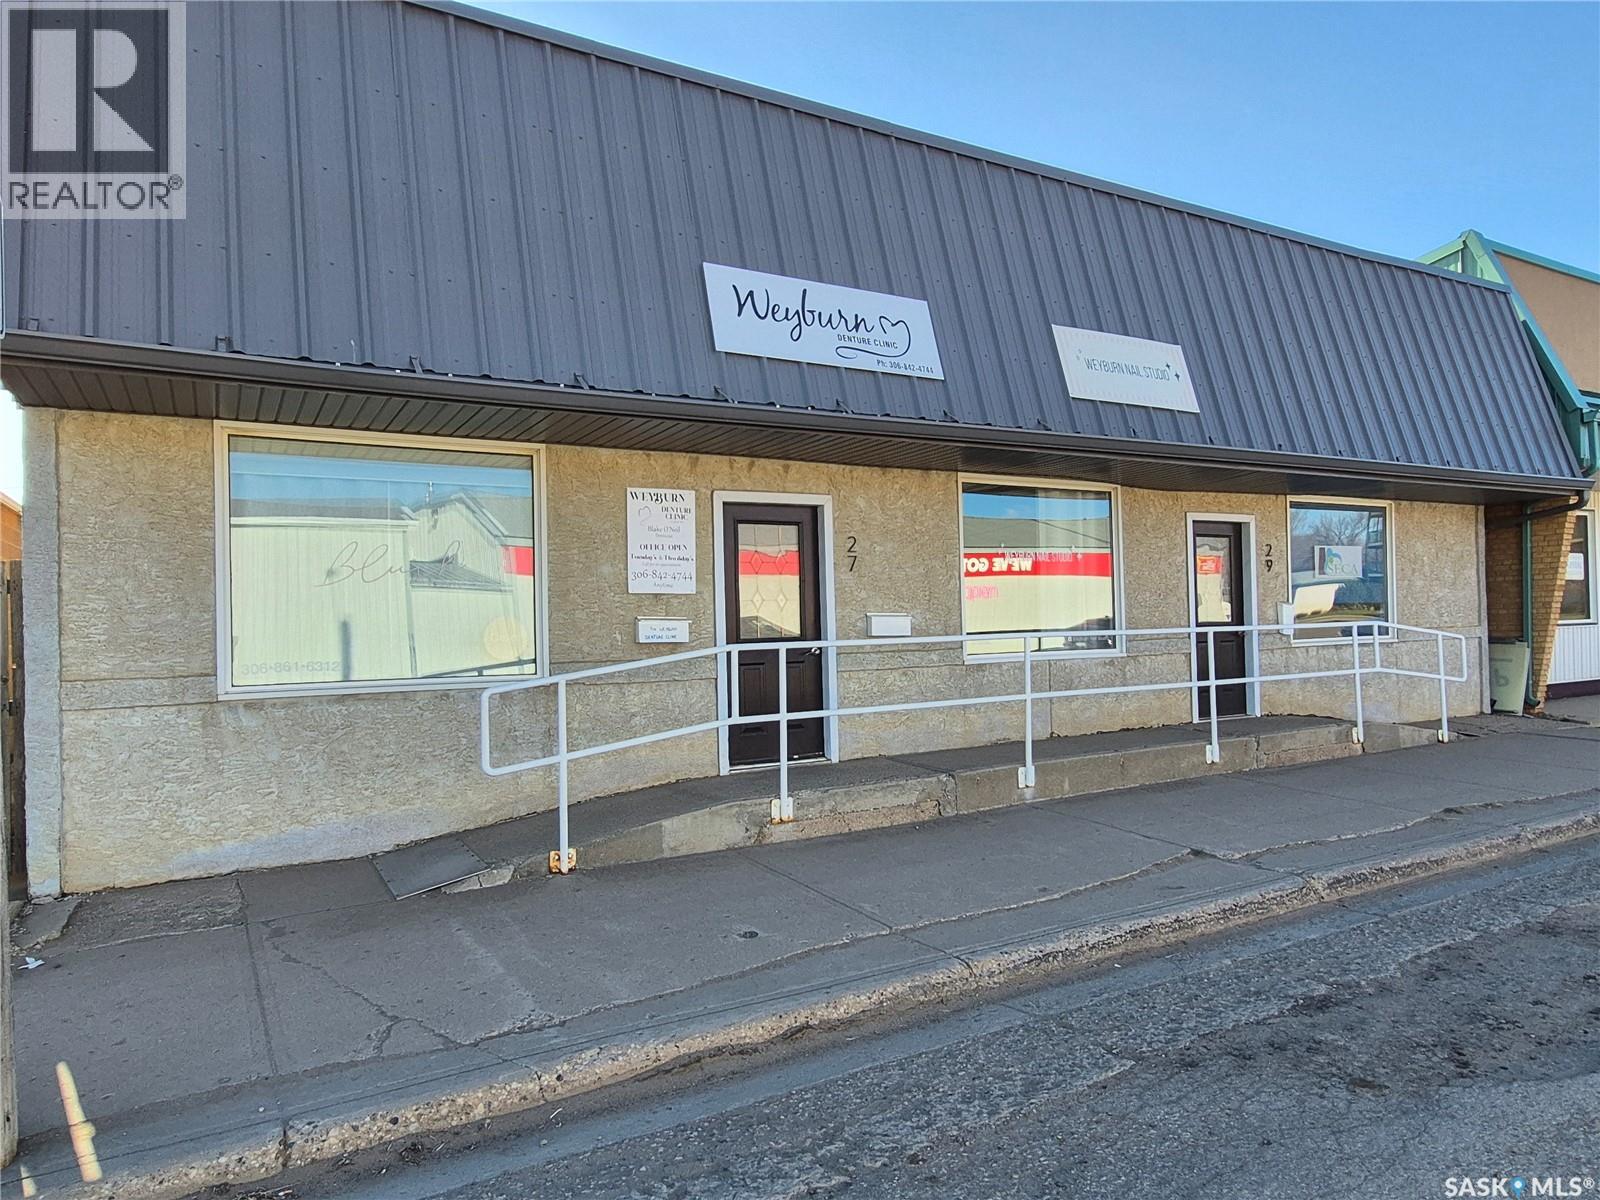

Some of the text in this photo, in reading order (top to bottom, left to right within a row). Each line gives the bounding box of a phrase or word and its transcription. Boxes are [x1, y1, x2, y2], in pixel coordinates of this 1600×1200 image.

[732, 284, 875, 342] Weyburn
[837, 333, 899, 349] DENTURE CLINIC
[889, 360, 934, 374] 306-842-4744
[1083, 357, 1170, 381] WEYBURN NAIL STUDIO
[630, 491, 685, 505] WEYBURN
[661, 506, 691, 514] DENTURE
[639, 543, 665, 551] OFFICE
[631, 569, 693, 581] 306-842-4744
